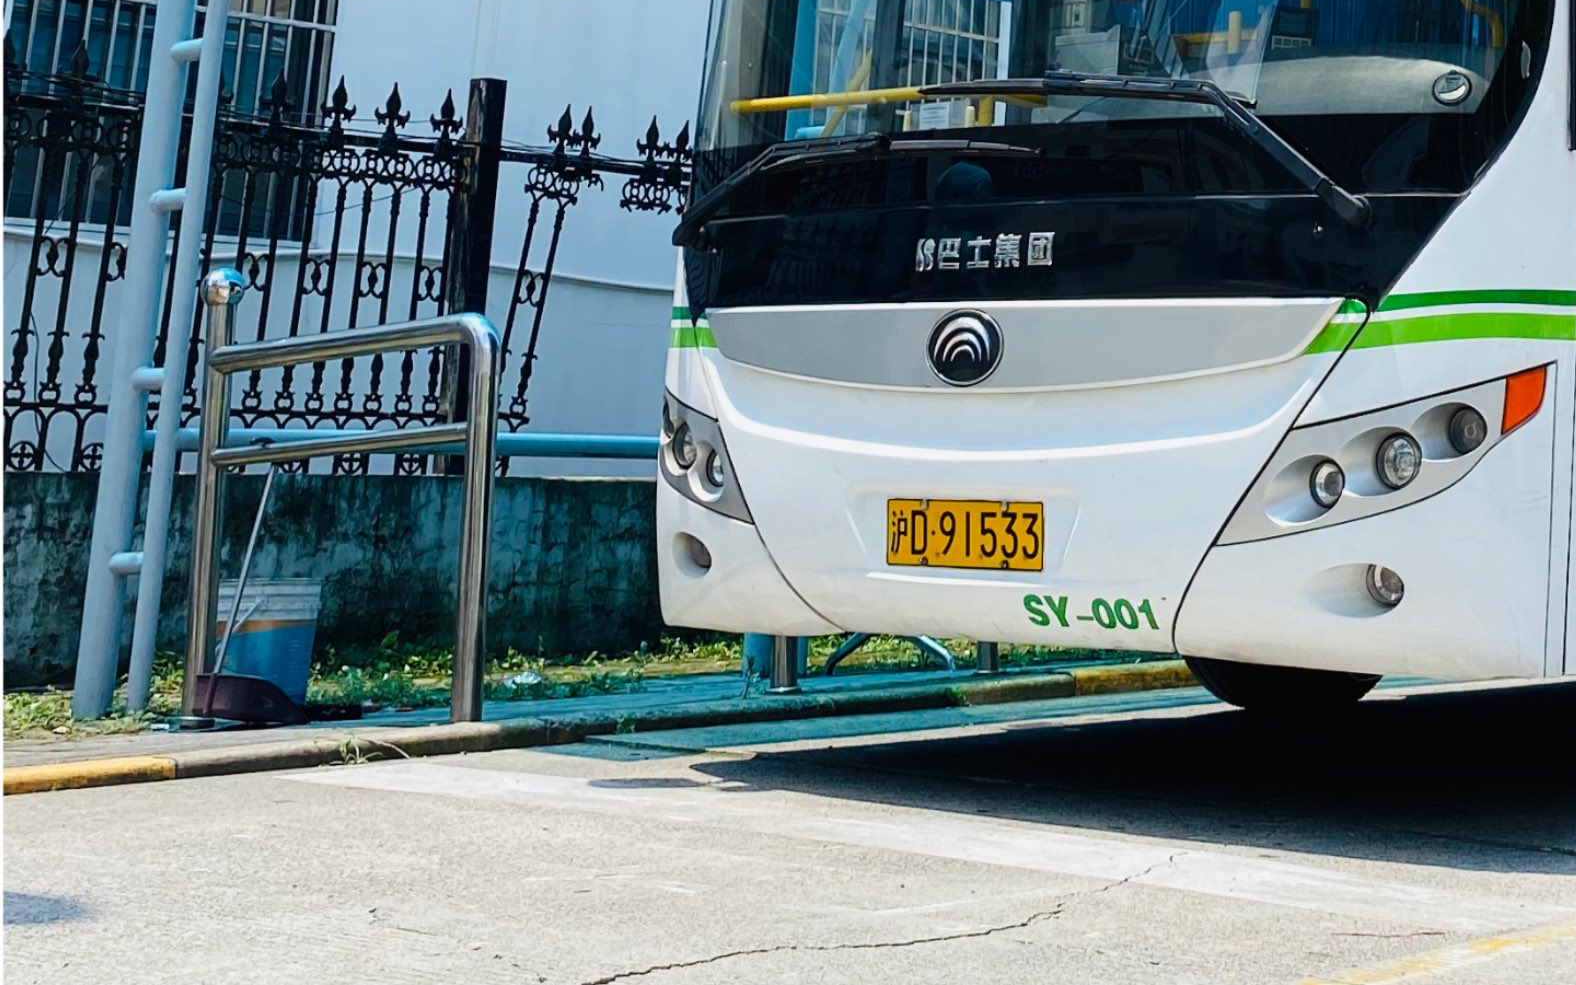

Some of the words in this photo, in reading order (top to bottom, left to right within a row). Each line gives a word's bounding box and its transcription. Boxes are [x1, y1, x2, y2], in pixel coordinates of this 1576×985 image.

[936, 231, 1056, 270] 巴士集团
[1022, 593, 1160, 631] SY-001
